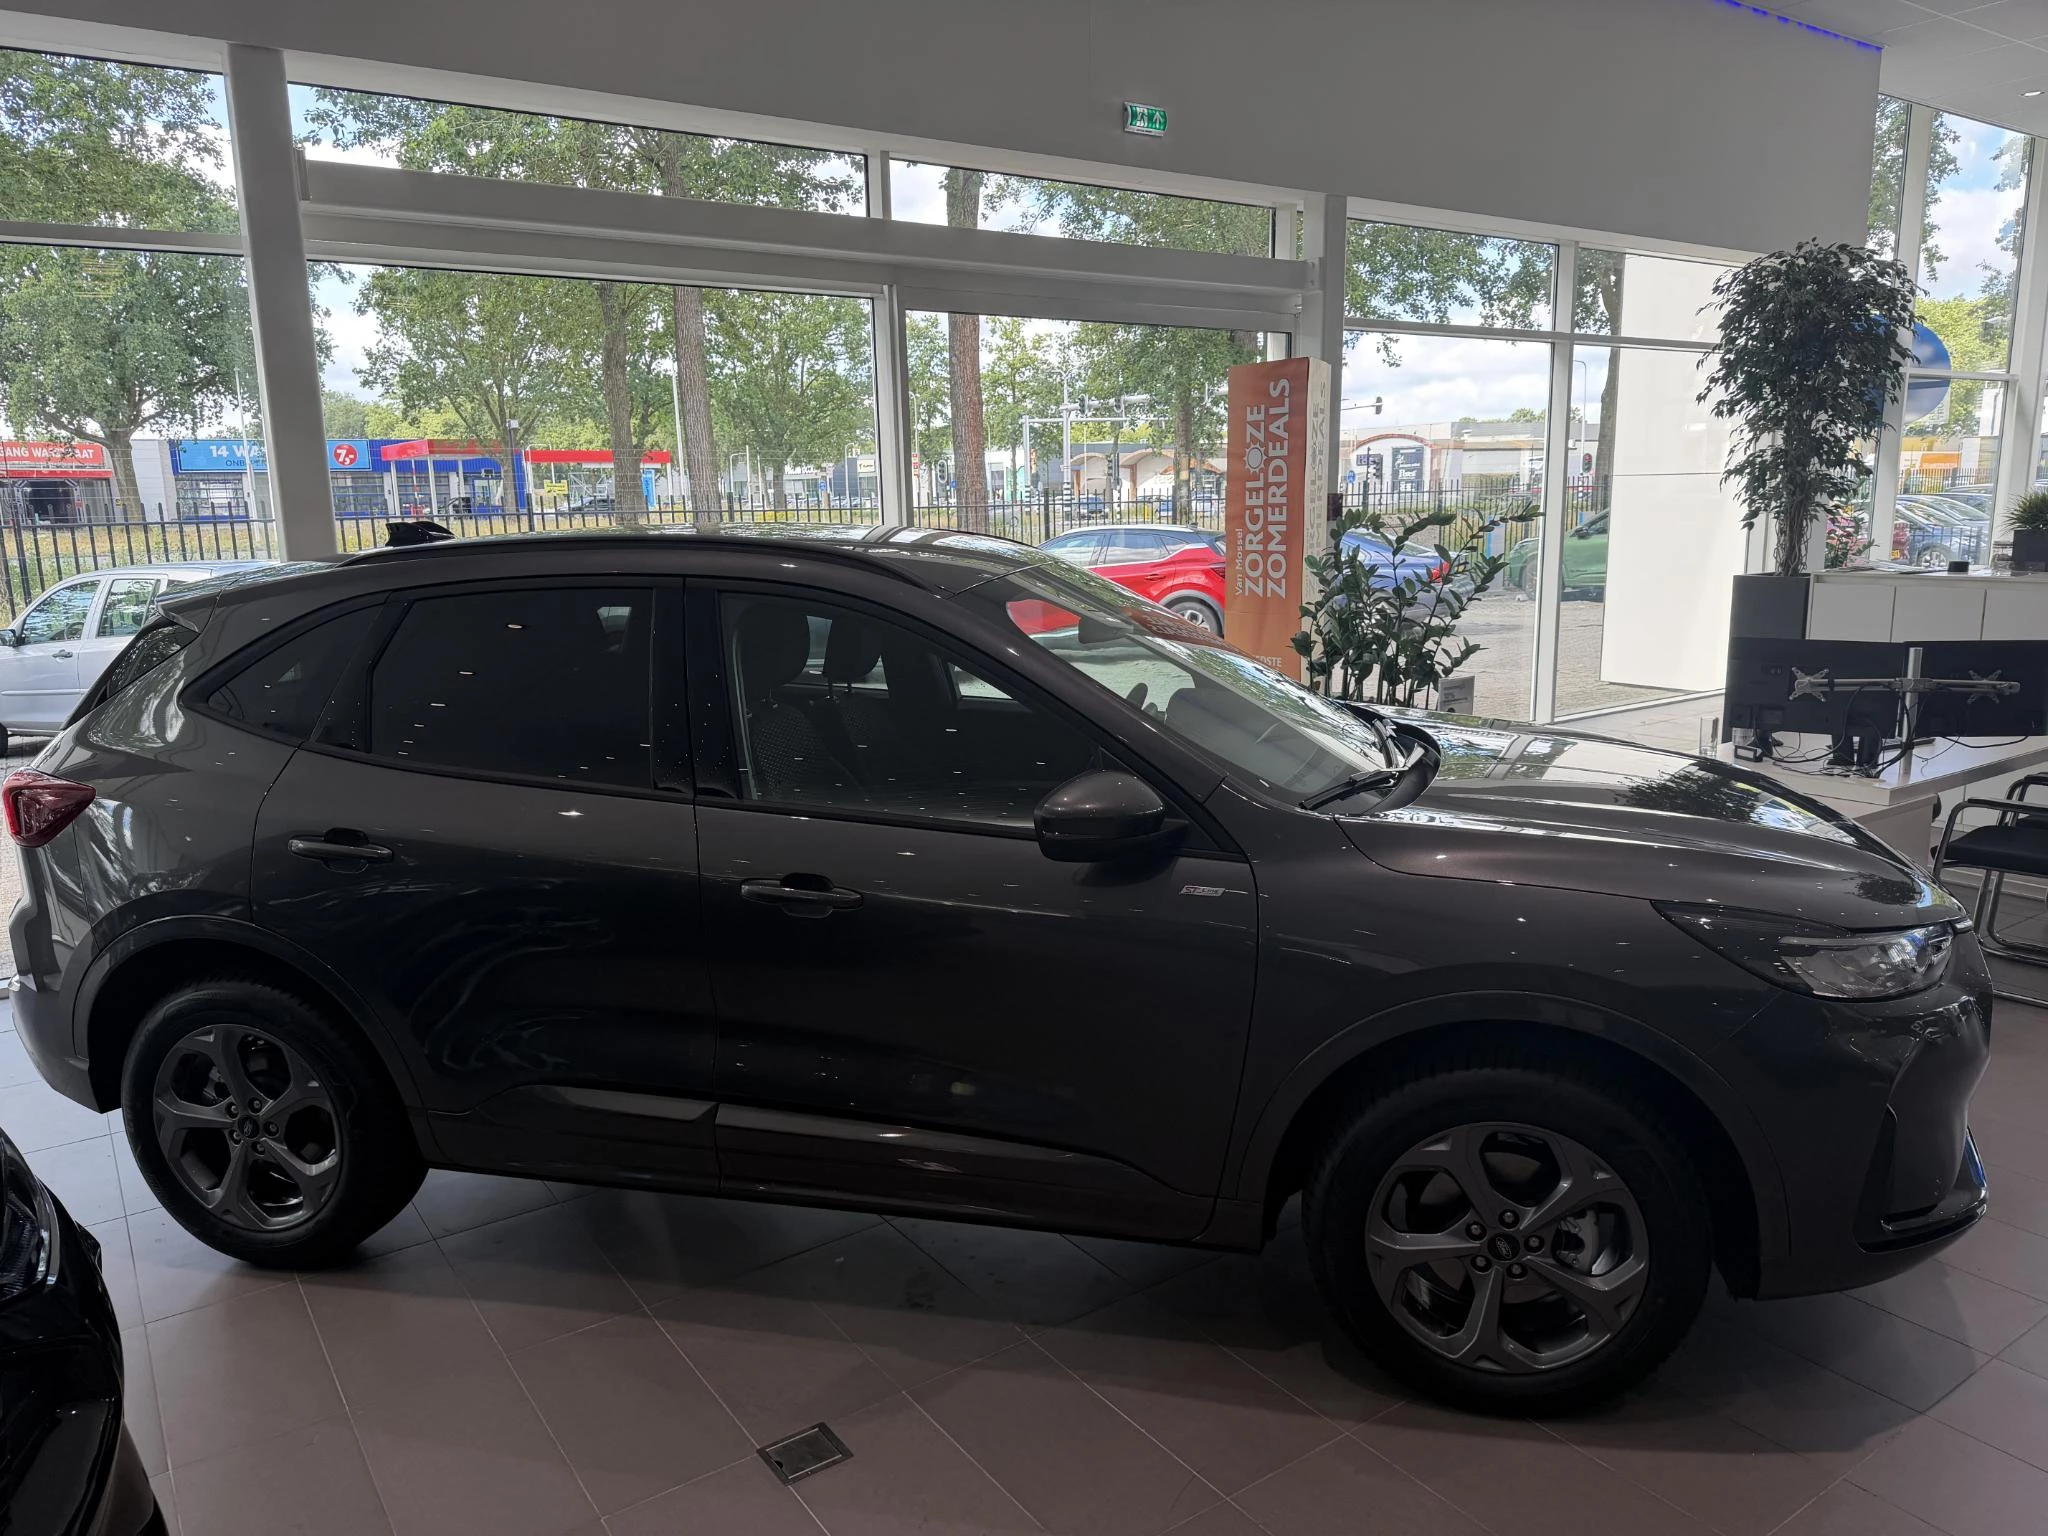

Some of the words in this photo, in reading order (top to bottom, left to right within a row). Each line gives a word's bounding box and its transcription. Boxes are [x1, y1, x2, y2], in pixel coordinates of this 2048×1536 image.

[209, 445, 229, 458] 14
[1267, 378, 1290, 600] ZOMERDEALS
[1235, 528, 1244, 570] Mossel
[1234, 573, 1244, 596] Van
